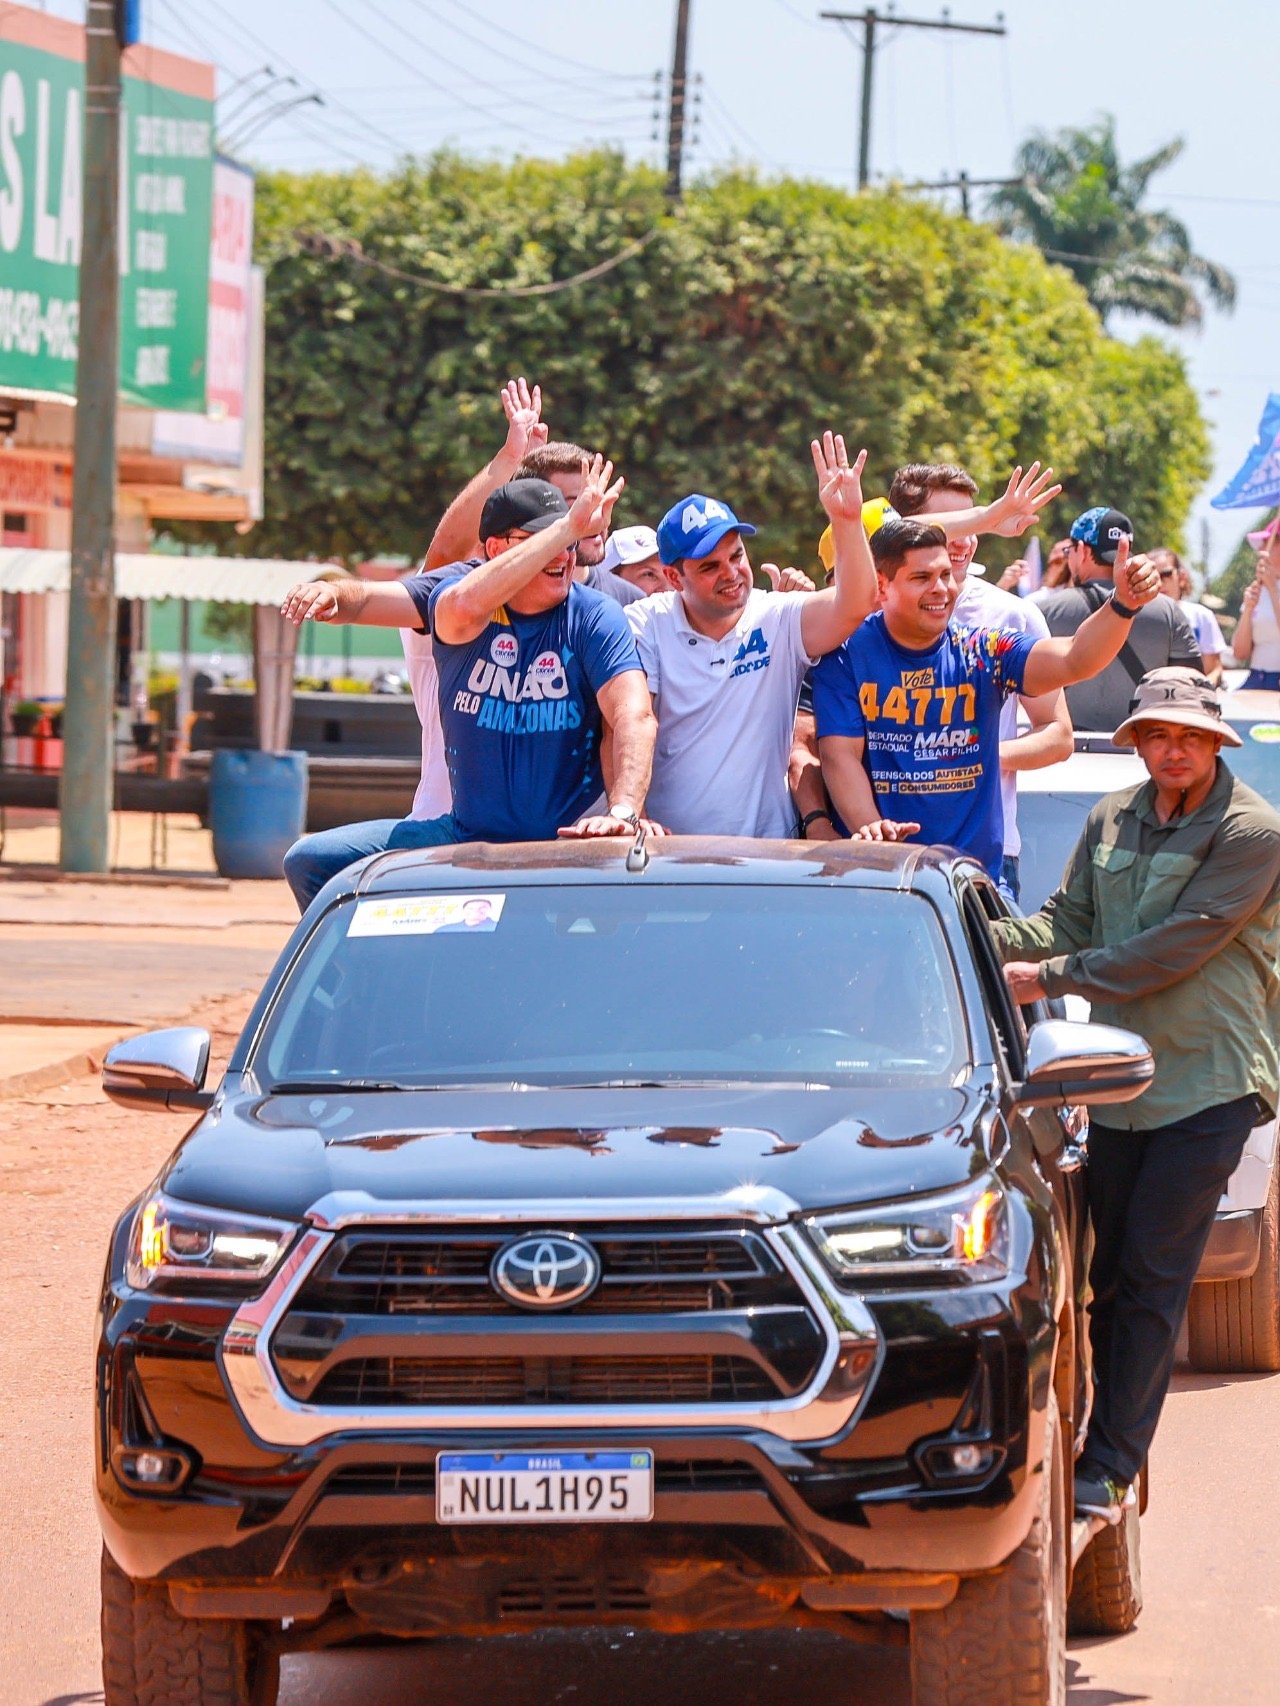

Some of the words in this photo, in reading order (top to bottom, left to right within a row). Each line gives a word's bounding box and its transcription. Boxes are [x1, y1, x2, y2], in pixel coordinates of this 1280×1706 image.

[681, 497, 728, 535] 44
[498, 640, 514, 650] 44
[538, 658, 555, 668] 44
[729, 655, 770, 679] IDADE
[904, 672, 932, 687] Vote
[453, 691, 481, 715] PELO
[858, 682, 976, 726] 44777
[868, 741, 909, 753] ESTADUAL
[951, 744, 980, 756] FILHO
[913, 770, 934, 780] DOS
[891, 784, 897, 792] E
[900, 780, 975, 792] CONSUMIDORES
[528, 1457, 562, 1470] BRASIL
[460, 1475, 629, 1513] NUL1H95
